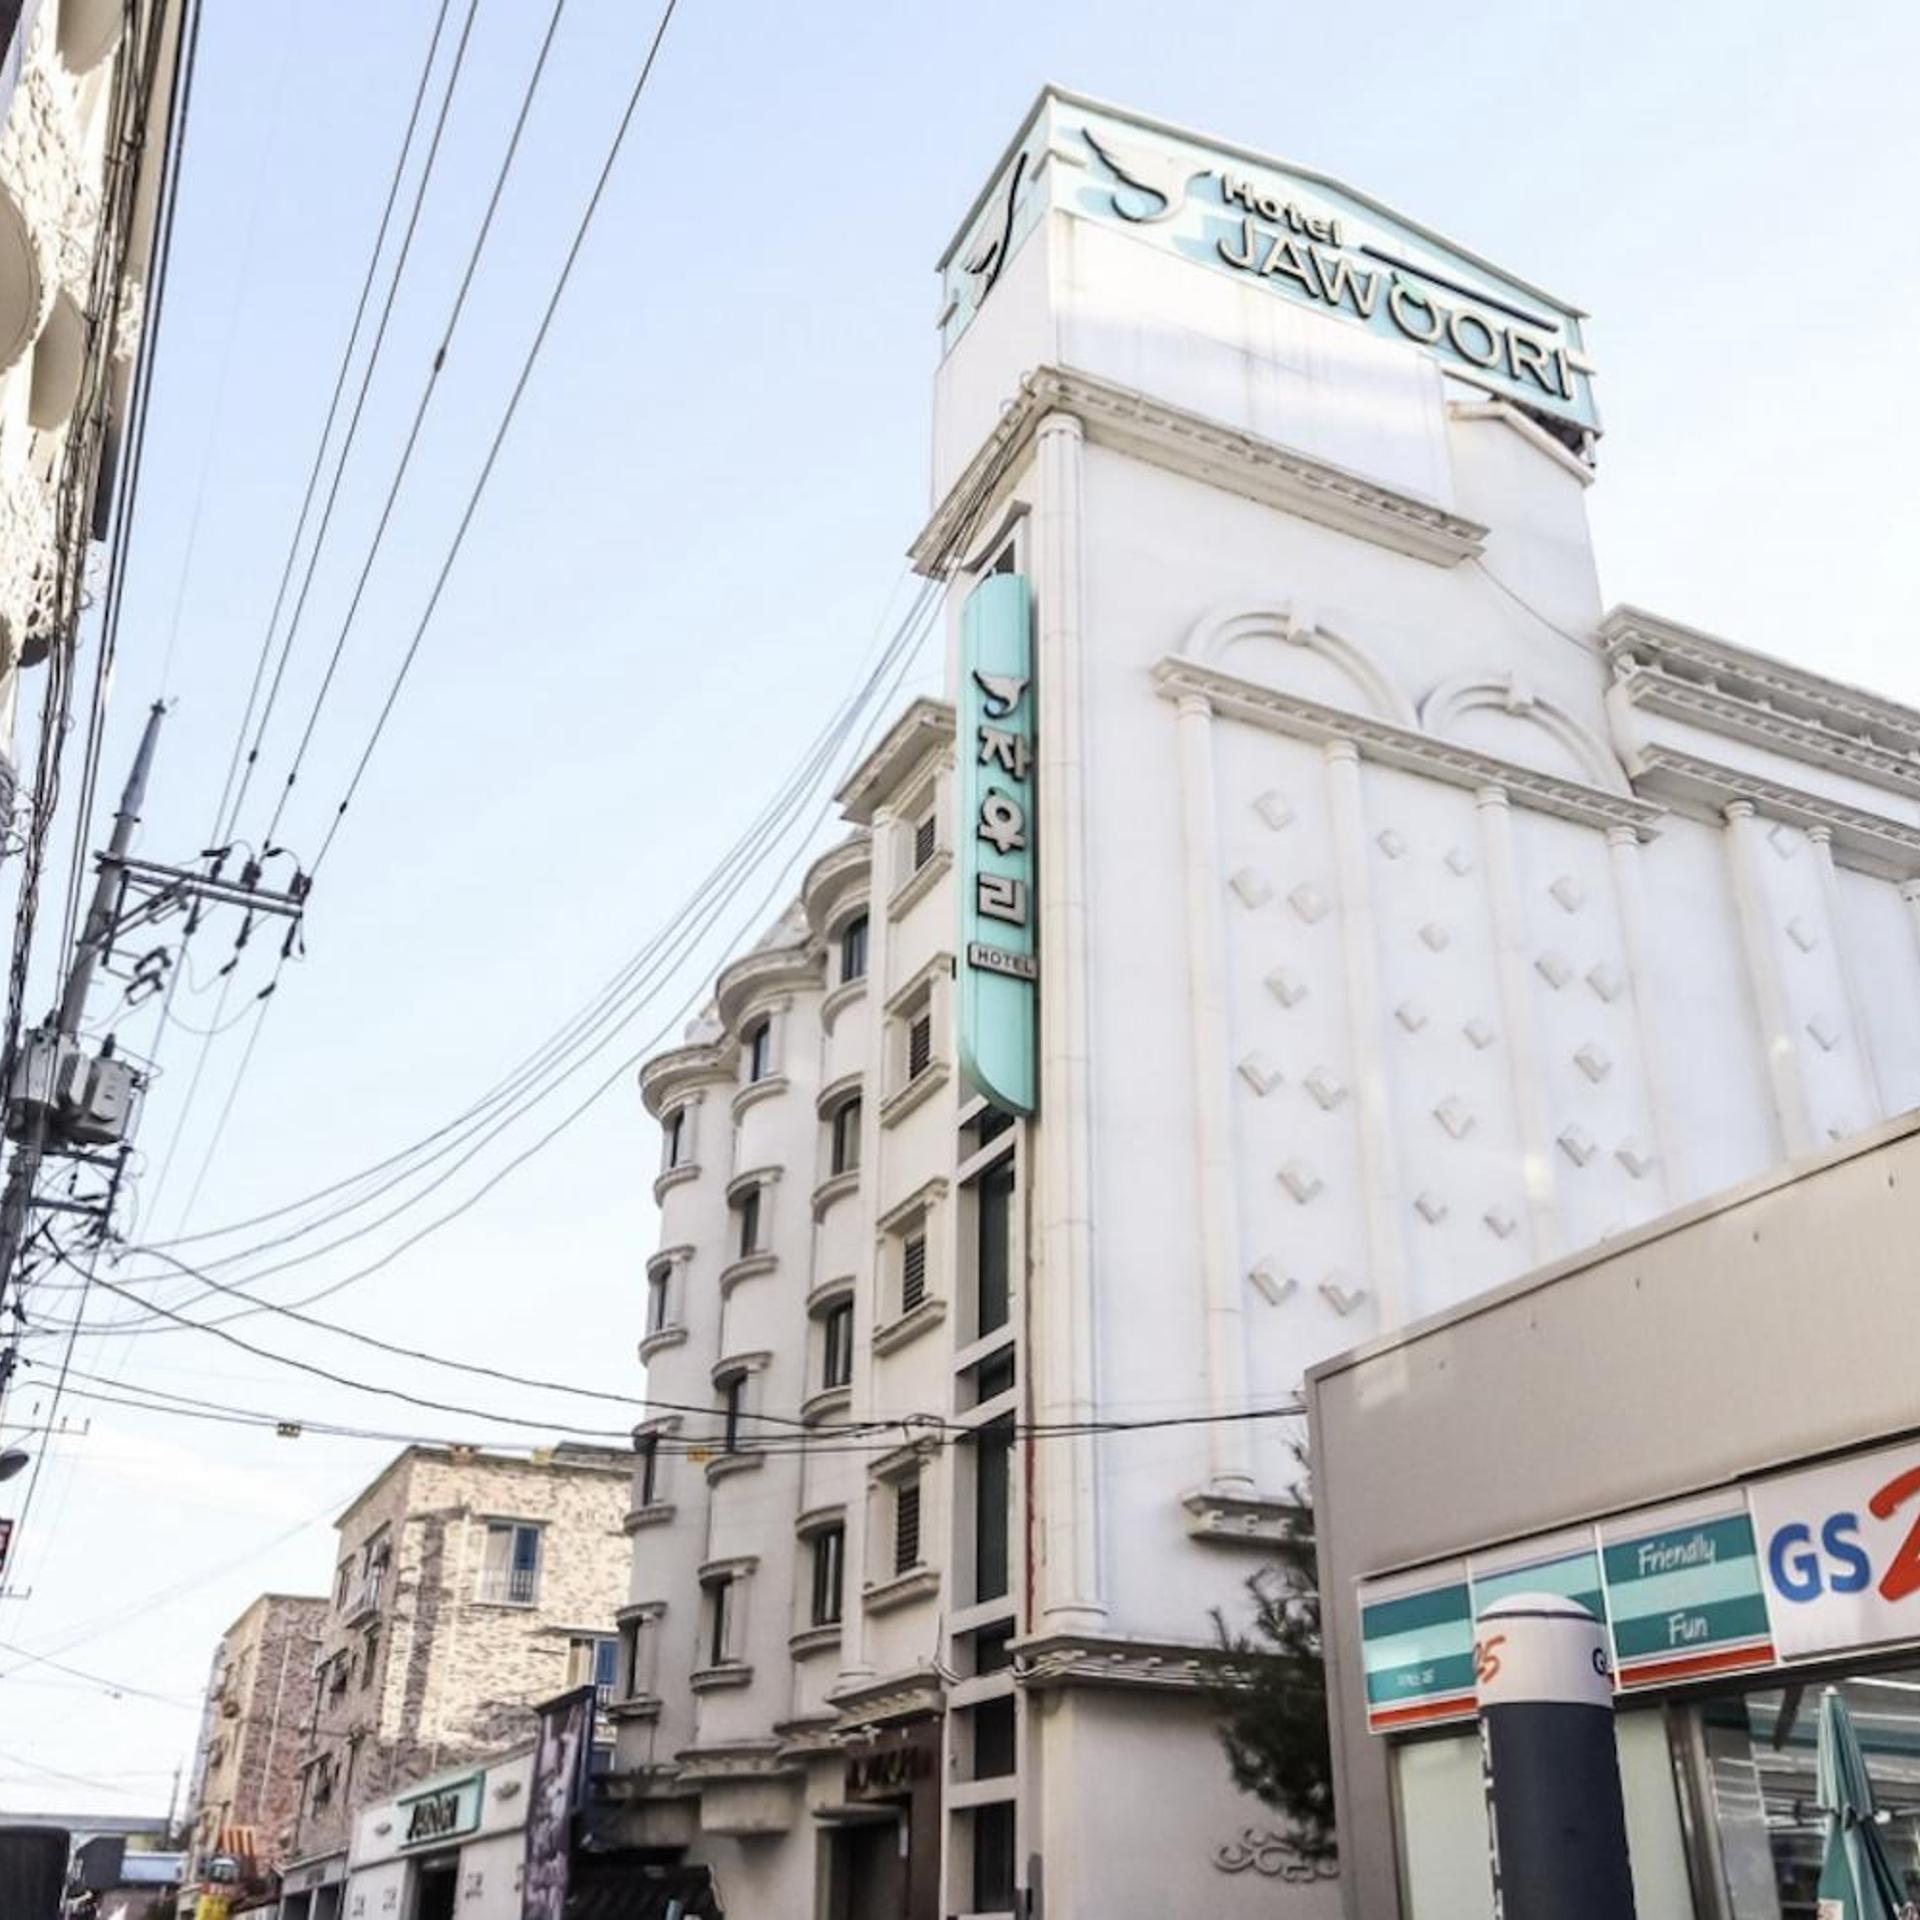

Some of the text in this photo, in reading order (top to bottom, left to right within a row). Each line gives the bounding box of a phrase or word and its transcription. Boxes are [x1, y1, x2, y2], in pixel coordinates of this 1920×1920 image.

[1220, 170, 1344, 249] Hotel
[1216, 218, 1576, 400] JAWOORI
[976, 950, 1034, 975] HOTEL
[1638, 1533, 1717, 1576] Friendly
[1668, 1613, 1708, 1645] Fun
